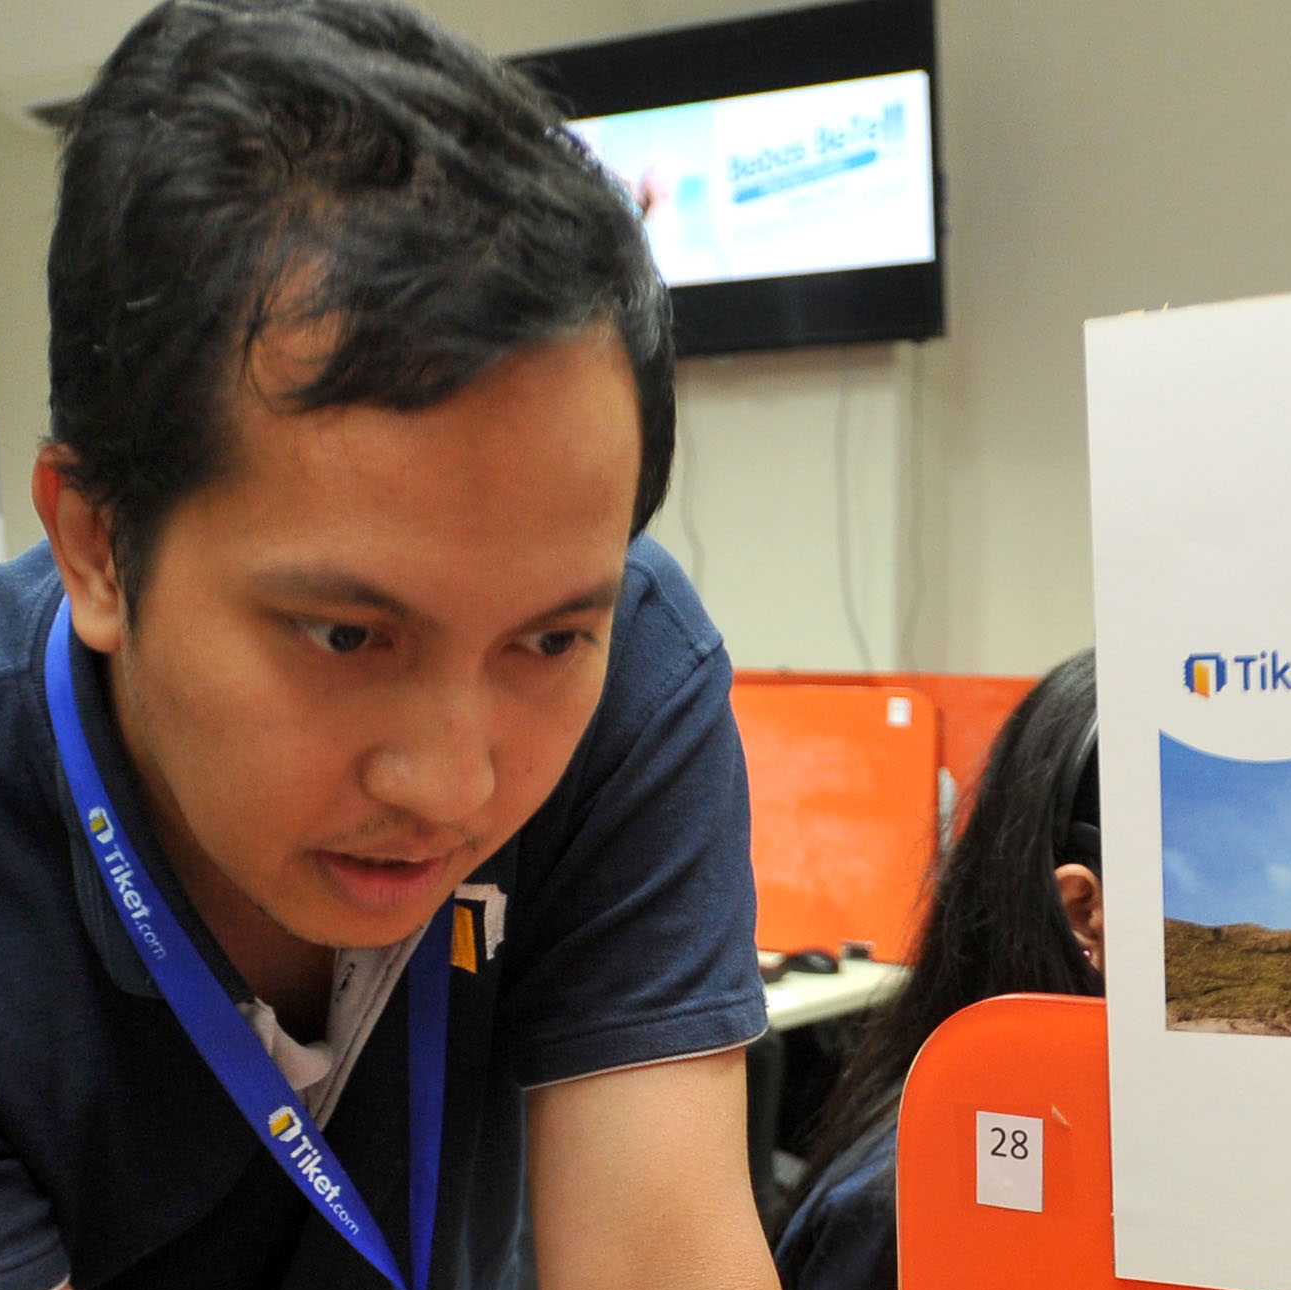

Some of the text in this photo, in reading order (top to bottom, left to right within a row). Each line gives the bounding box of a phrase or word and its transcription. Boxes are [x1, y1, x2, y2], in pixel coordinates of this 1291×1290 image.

[104, 844, 167, 960] Tiket.com
[290, 1135, 360, 1236] Tiket.com
[990, 1127, 1029, 1160] 28
